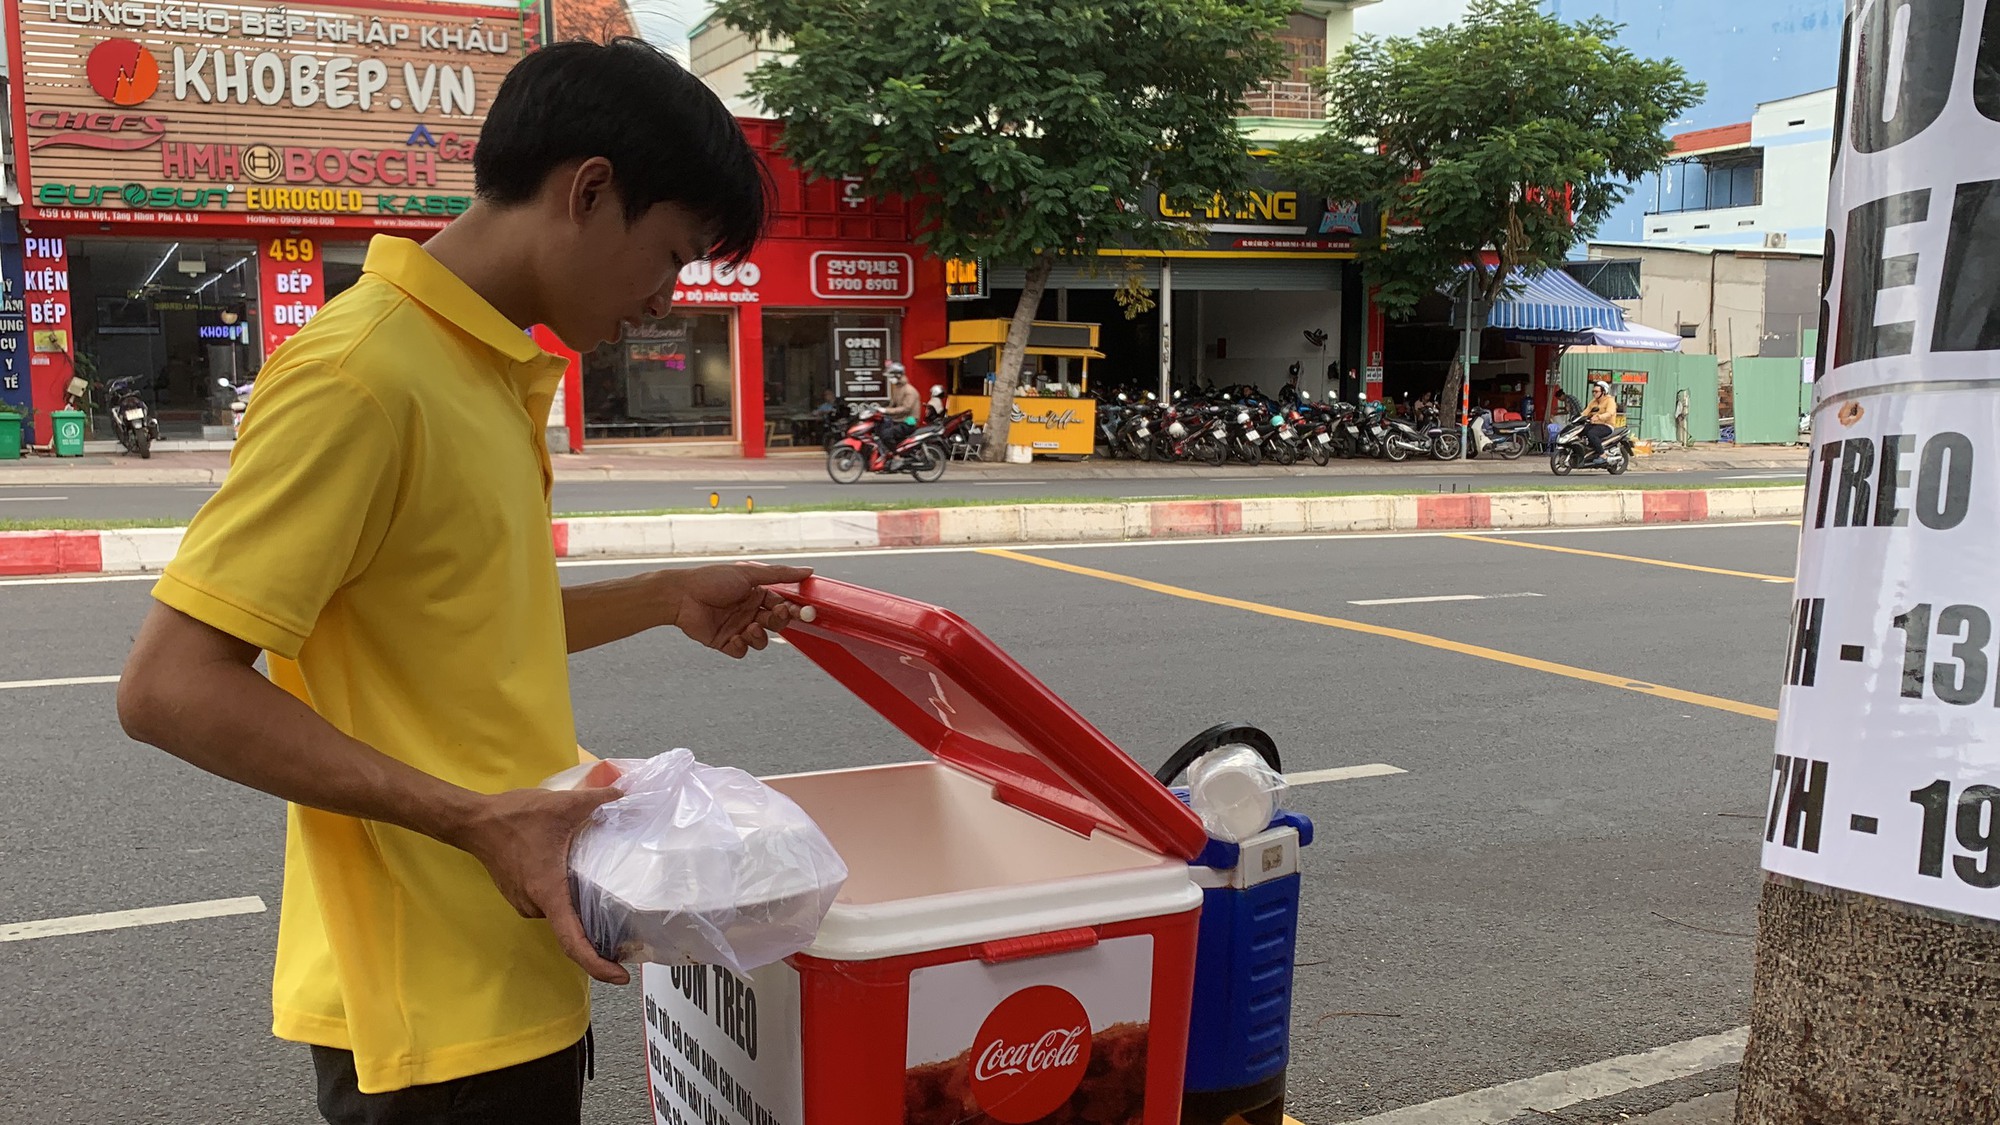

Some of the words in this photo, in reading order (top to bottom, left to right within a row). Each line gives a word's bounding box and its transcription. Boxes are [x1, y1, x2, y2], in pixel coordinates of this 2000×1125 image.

[156, 5, 230, 33] KHO
[241, 4, 307, 38] BẾP
[316, 16, 410, 51] NHẬP
[421, 18, 509, 54] KHẨU
[173, 46, 476, 116] KHOBEP.VN
[161, 142, 240, 180] HMH
[284, 146, 437, 186] BOSCH
[39, 208, 59, 218] 459
[246, 187, 363, 212] EUROGOLD
[1159, 190, 1297, 220] MNG
[25, 238, 63, 262] PHỤ
[269, 238, 314, 262] 459
[25, 267, 68, 294] KIỆN
[276, 268, 313, 294] BẾP
[827, 278, 862, 290] 1900
[865, 278, 898, 290] 8901
[30, 297, 67, 324] BẾP
[0, 319, 24, 332] ỤNG
[200, 326, 243, 338] KHOBP
[1, 338, 17, 353] CỤ
[845, 338, 880, 348] OPEN
[5, 359, 13, 370] Y
[1814, 431, 1973, 530] TREO
[1893, 603, 2000, 708] 13
[712, 964, 758, 1061] TREO
[975, 1026, 1087, 1081] Coca-Cola
[684, 1030, 700, 1071] CHÚ
[702, 1049, 718, 1090] ANH
[719, 1066, 734, 1112] CHỊ
[755, 1101, 783, 1125] KH
